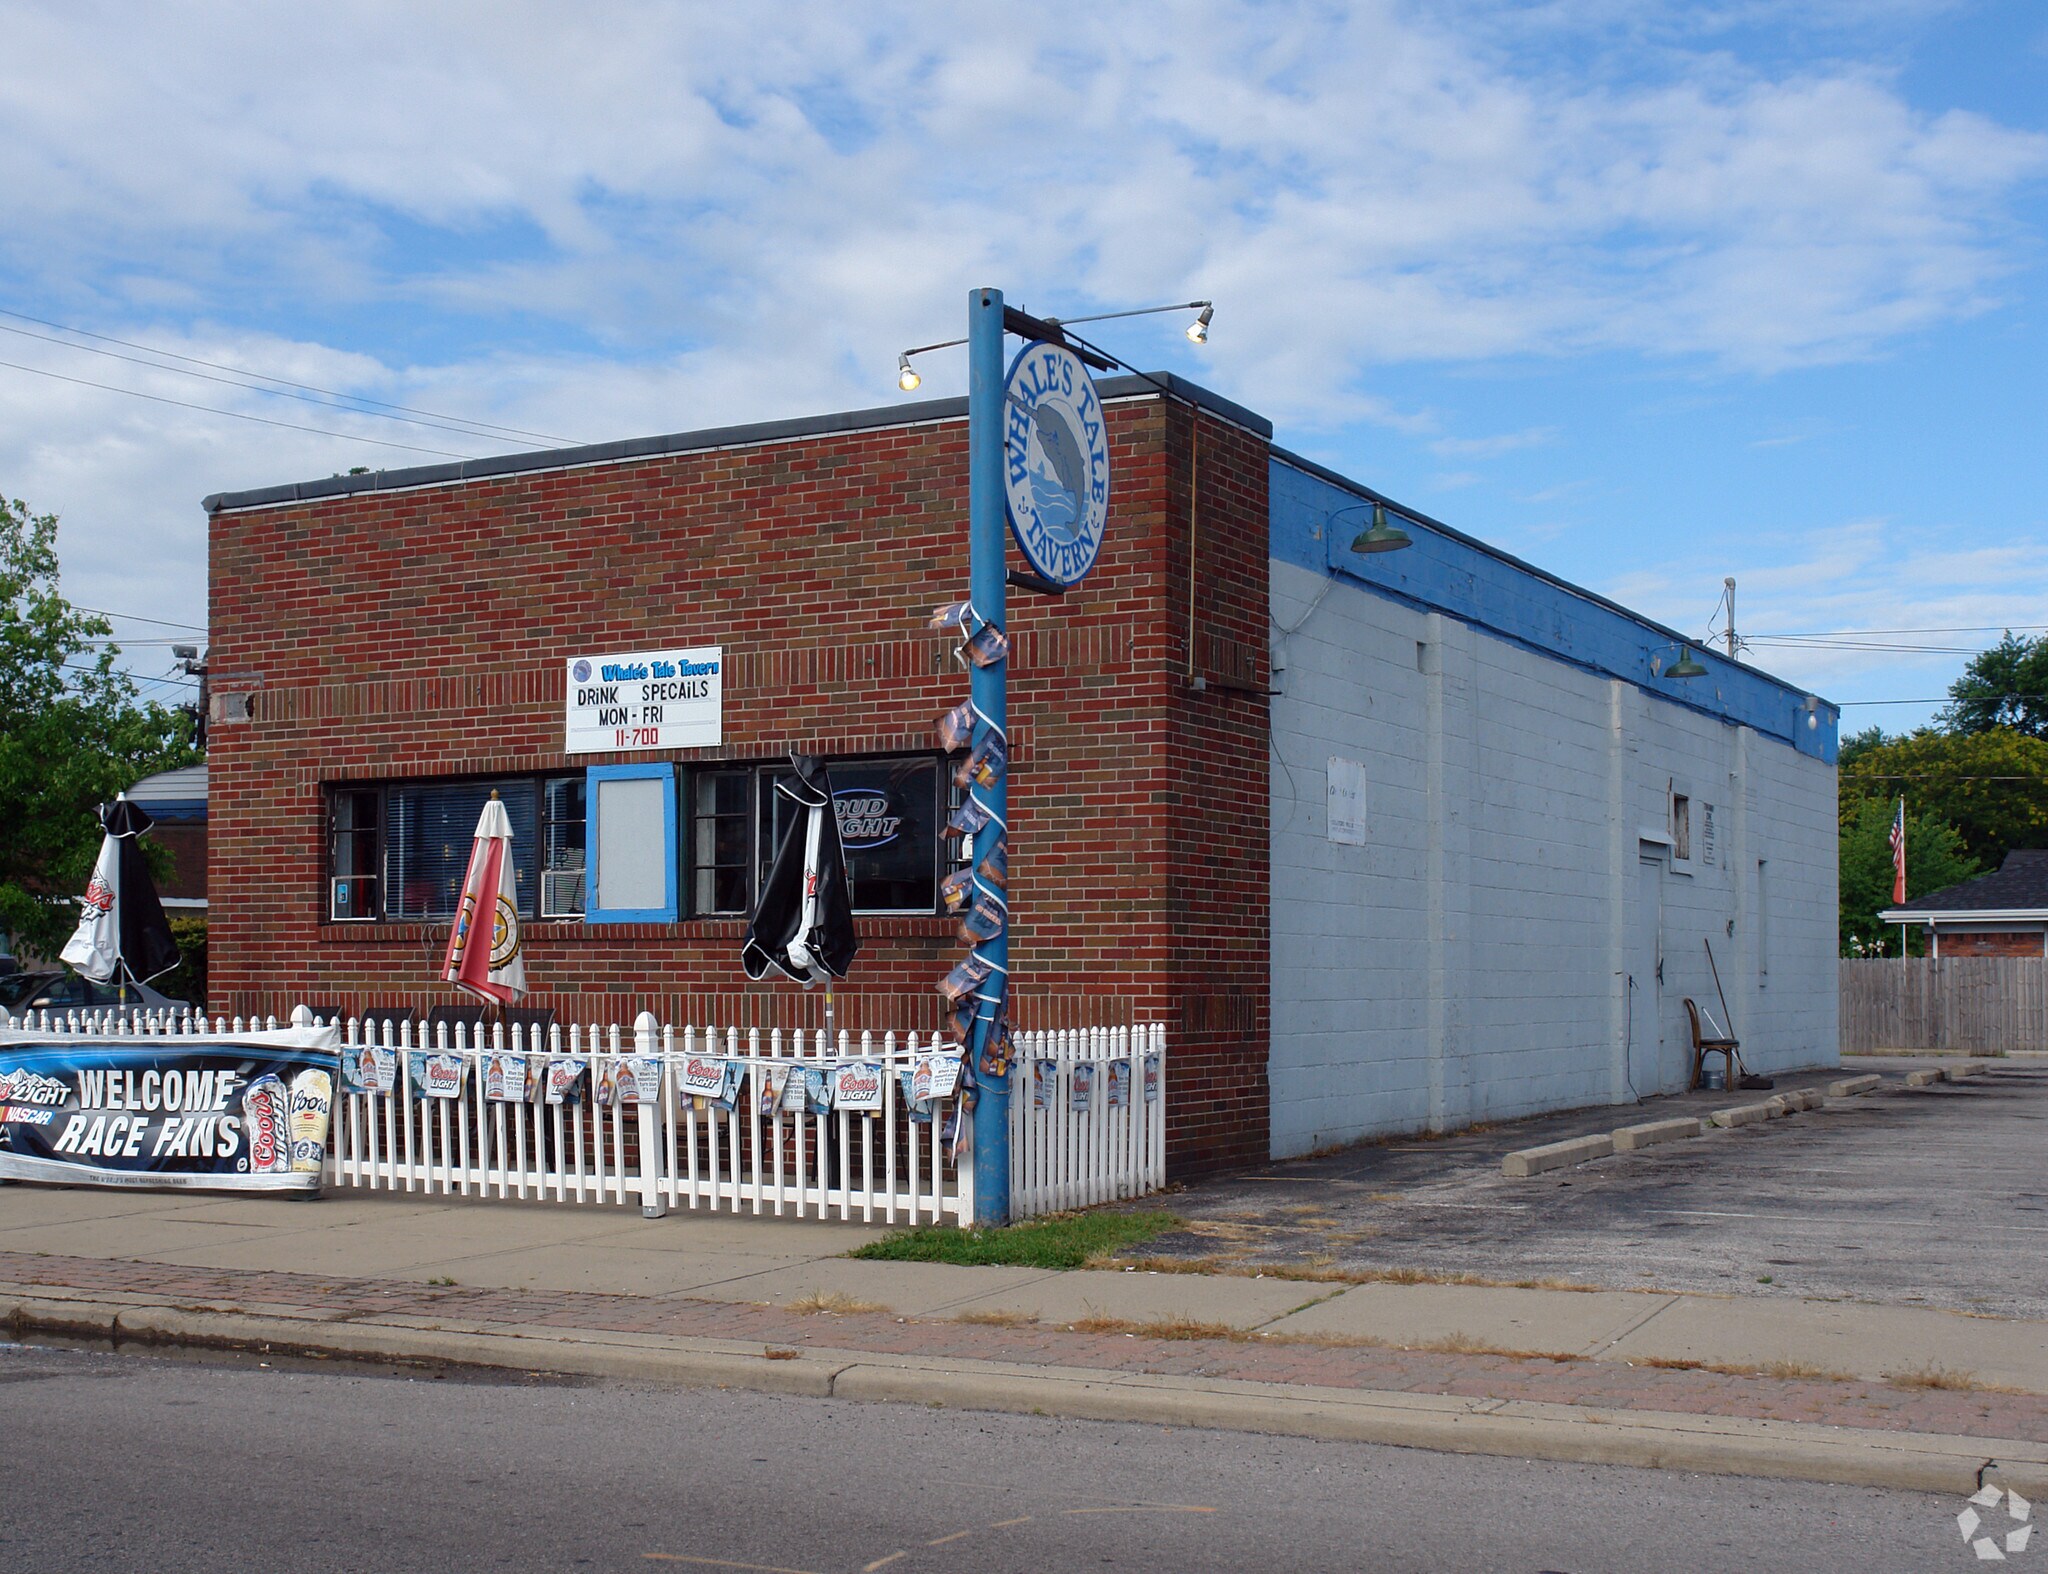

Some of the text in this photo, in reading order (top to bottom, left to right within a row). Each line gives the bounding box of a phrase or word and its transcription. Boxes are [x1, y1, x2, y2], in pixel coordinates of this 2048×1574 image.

[1009, 353, 1105, 504] WHALE'S TALE
[1026, 508, 1095, 578] TAVERN
[601, 662, 649, 682] Whale's
[651, 661, 676, 679] Tale
[679, 659, 719, 676] Tavern
[599, 707, 628, 726] MON
[643, 706, 663, 724] FRI
[833, 799, 888, 819] BUD
[837, 817, 901, 838] GHT
[430, 1064, 459, 1080] Coors
[687, 1059, 722, 1080] Coors
[77, 1069, 238, 1112] WELCOME
[431, 1080, 456, 1089] LIGHT
[686, 1075, 718, 1089] LIGHT
[841, 1074, 879, 1091] Coors
[10, 1085, 72, 1106] LIGHT
[291, 1089, 328, 1114] Coors
[840, 1090, 876, 1102] LIGHT
[6, 1106, 54, 1126] NASCAR
[53, 1114, 242, 1158] RACE FANS
[251, 1092, 277, 1169] Coors
[269, 1089, 289, 1165] LIGHT
